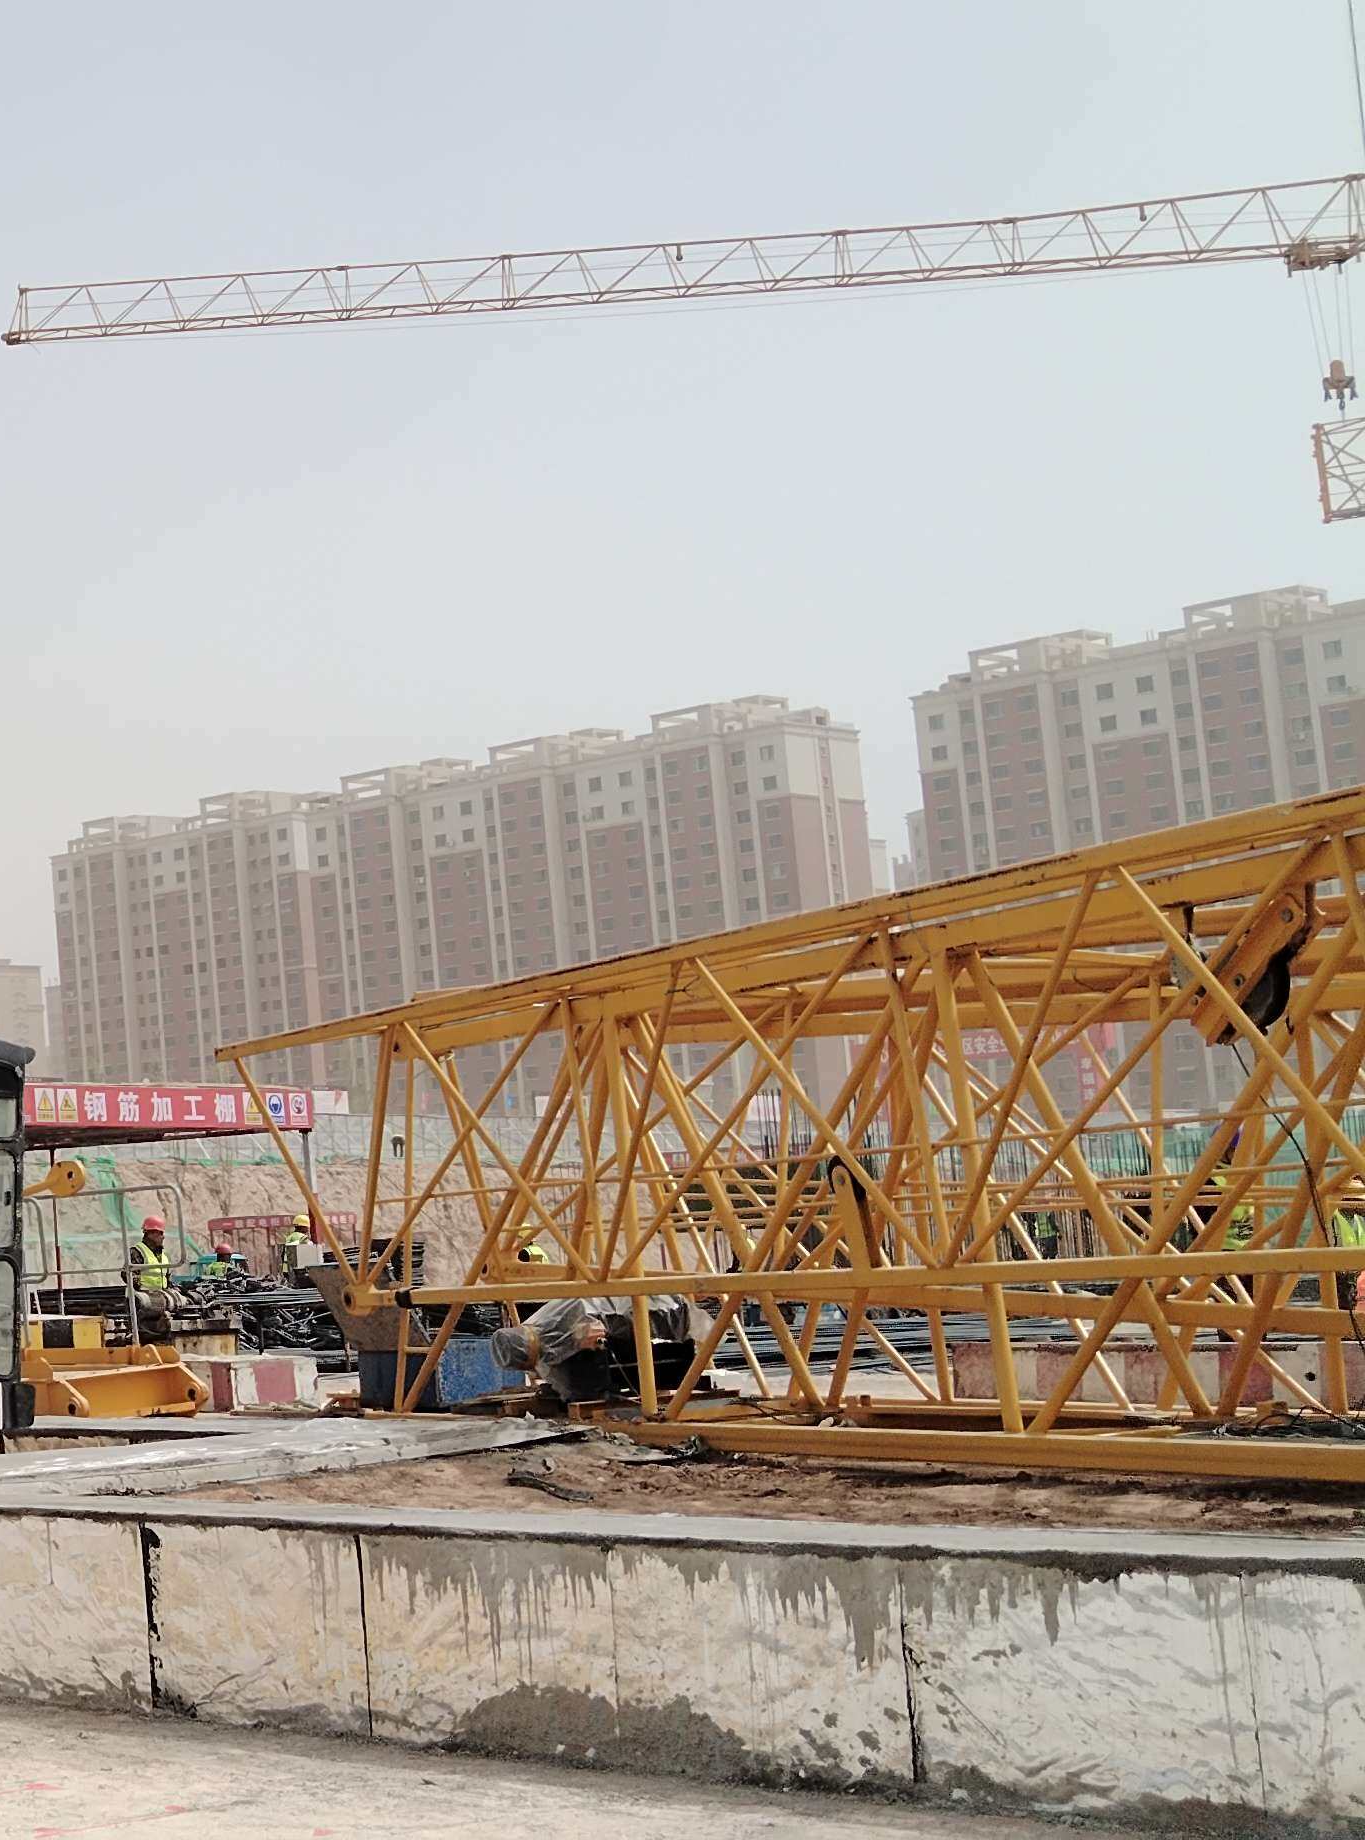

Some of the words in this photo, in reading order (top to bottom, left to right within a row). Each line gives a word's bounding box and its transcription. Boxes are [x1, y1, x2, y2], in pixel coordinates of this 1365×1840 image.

[83, 1090, 237, 1123] 钢筋加工棚
